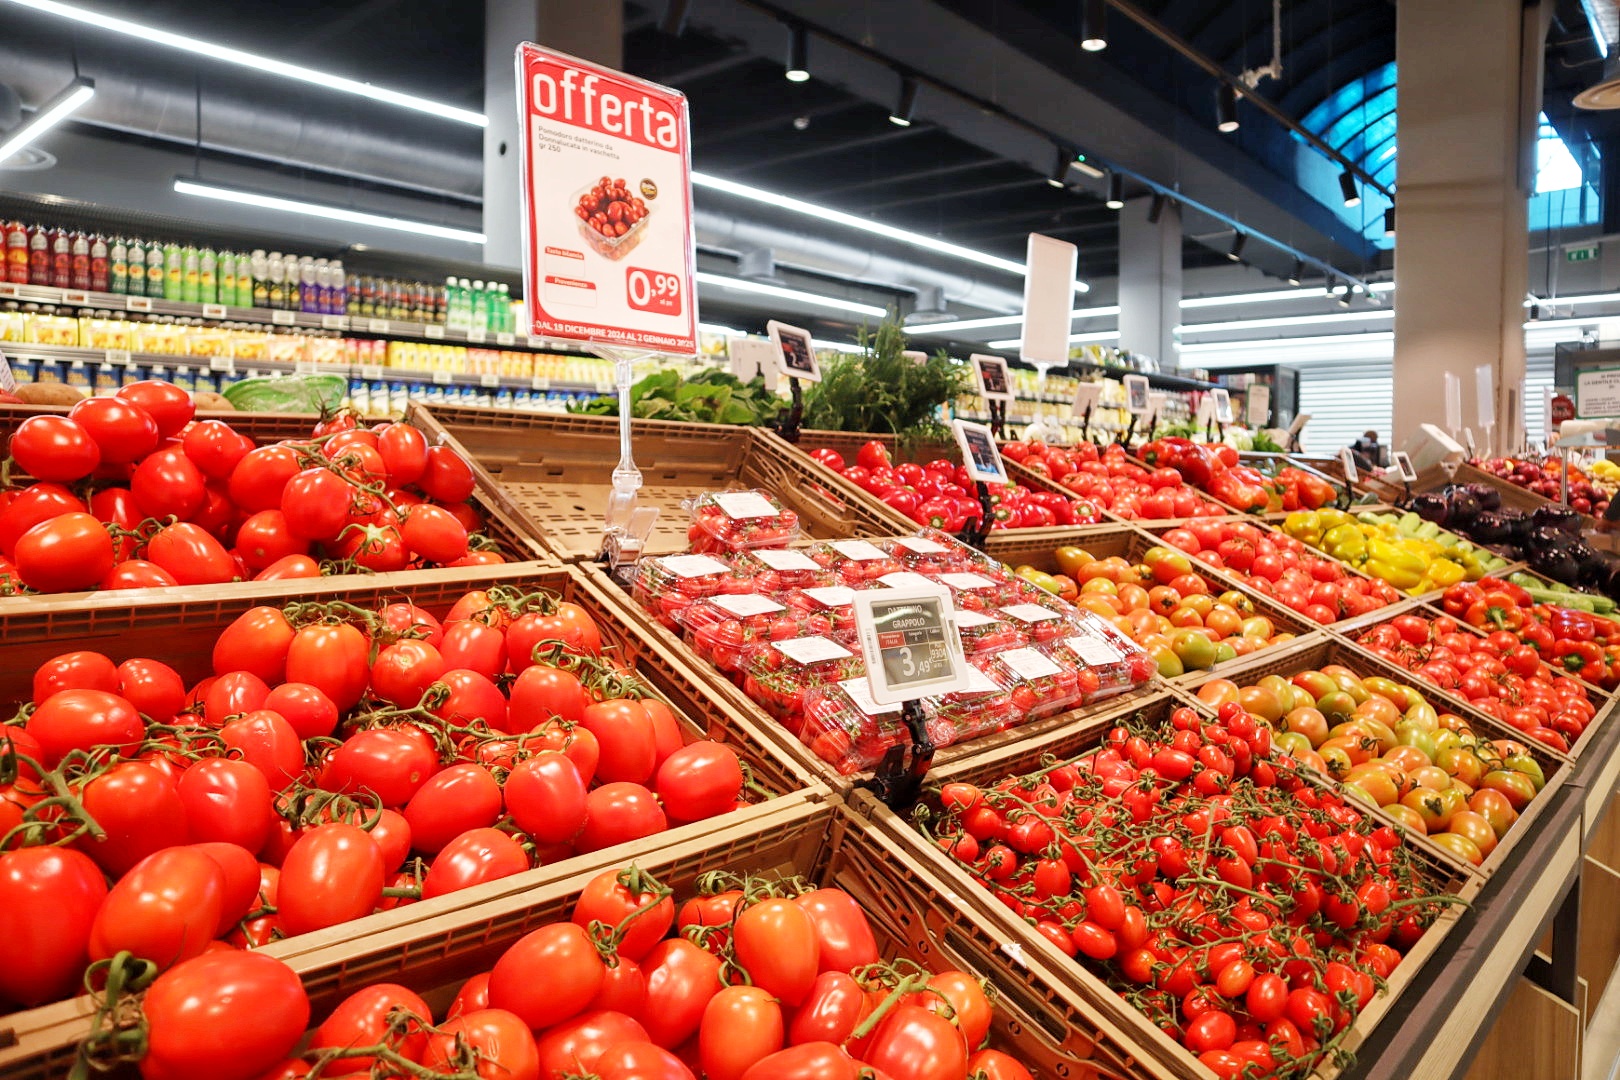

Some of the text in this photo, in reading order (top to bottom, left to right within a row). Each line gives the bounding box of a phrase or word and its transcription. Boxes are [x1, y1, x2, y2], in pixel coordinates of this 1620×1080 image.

[533, 69, 677, 148] offerta
[538, 125, 613, 151] Pomodoro datterino da
[548, 143, 561, 153] 250
[590, 148, 620, 160] vaschetta
[629, 270, 679, 306] 0,99
[535, 320, 552, 331] DAL
[553, 322, 563, 332] 19
[565, 324, 607, 337] DICEMBRE
[607, 329, 626, 339] 2024
[626, 332, 637, 341] AL
[637, 333, 643, 342] 2
[643, 334, 676, 346] GENNAIO
[892, 618, 925, 628] GRAPPOLO
